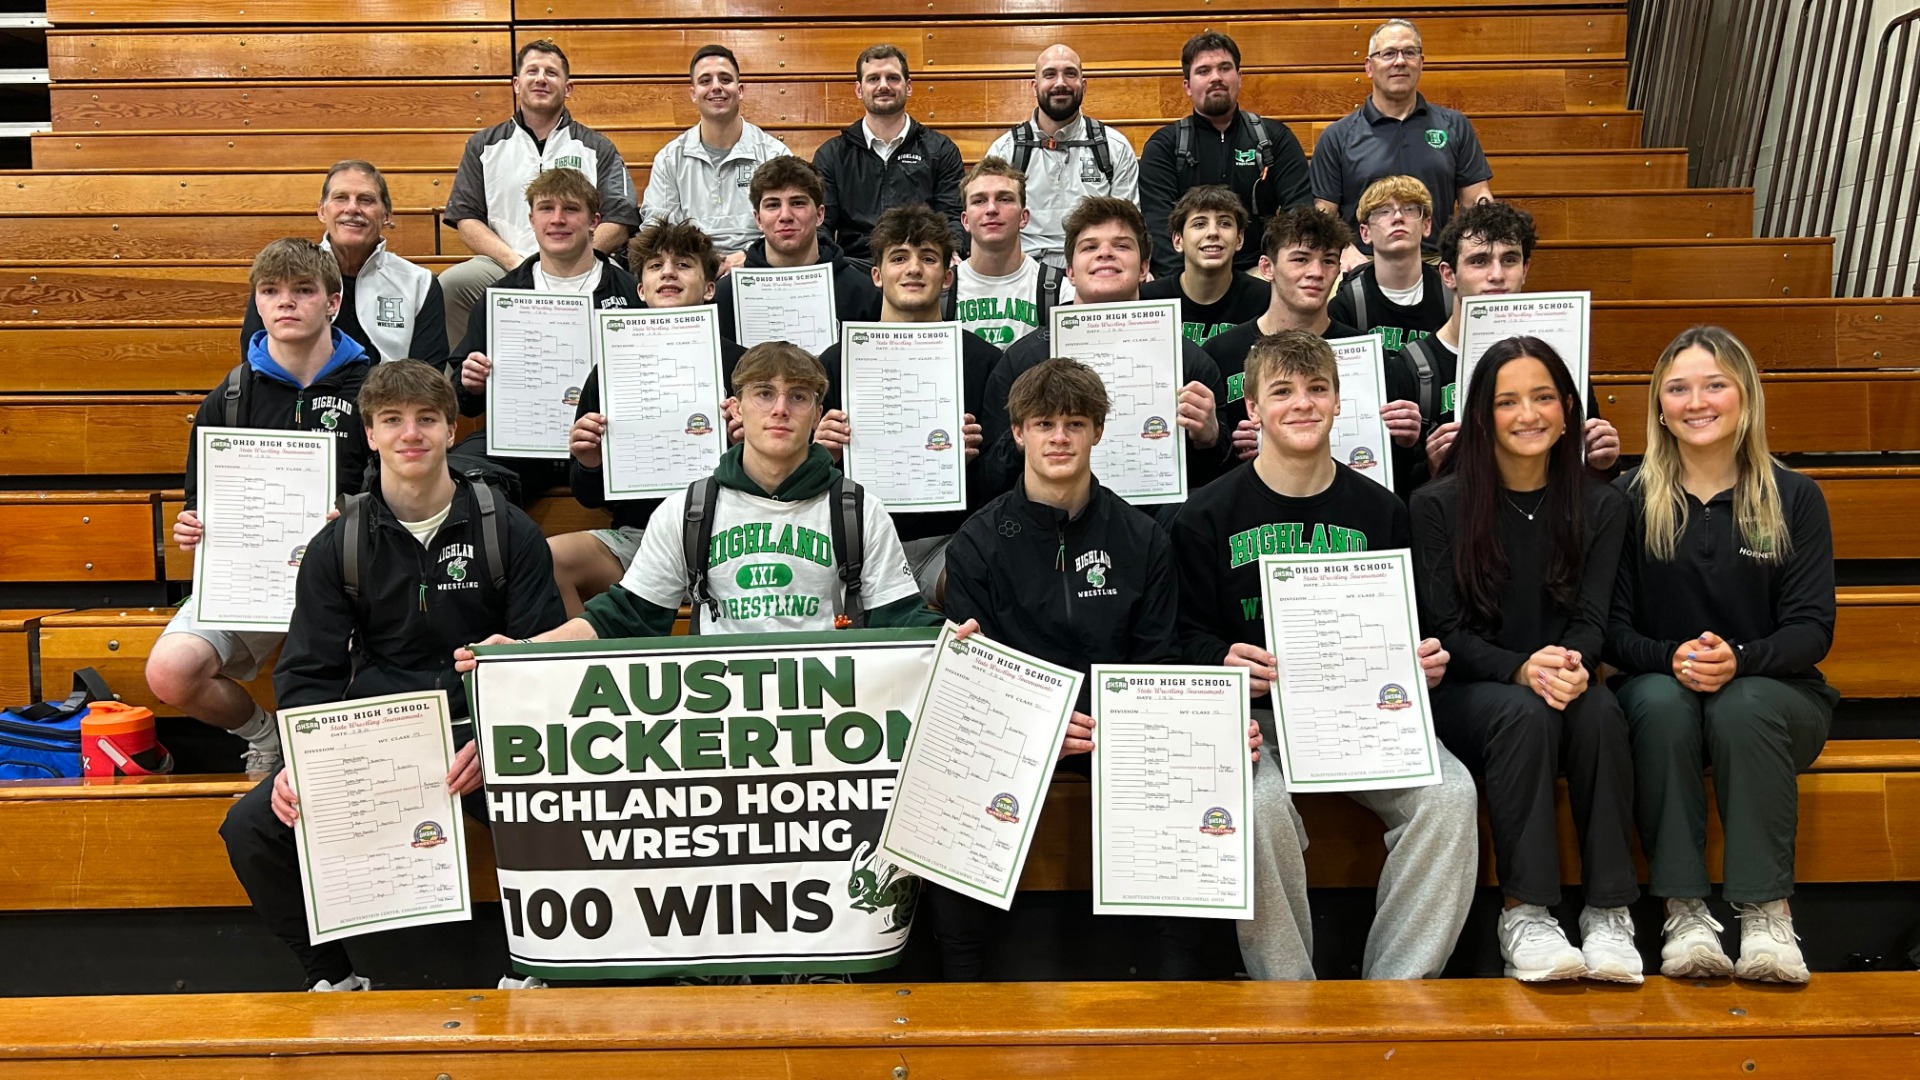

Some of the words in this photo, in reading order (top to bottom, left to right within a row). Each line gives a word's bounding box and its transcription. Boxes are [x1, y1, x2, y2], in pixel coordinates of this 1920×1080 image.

[377, 296, 404, 322] H
[312, 396, 352, 416] HIGHLAND
[311, 428, 348, 438] WREING
[708, 523, 832, 568] HIGHLAND
[1229, 522, 1367, 569] HIGHLAND
[750, 566, 778, 586] XXL
[1354, 563, 1394, 572] SCHOOL
[438, 582, 478, 590] WRESTLING
[1078, 588, 1117, 598] WRESTLING
[971, 646, 993, 661] OHIO
[997, 657, 1021, 672] HIGH
[1025, 668, 1062, 687] SCHOOL
[975, 657, 988, 668] State
[990, 663, 1016, 680] Wrestling
[569, 656, 857, 718] AUSTIN
[322, 715, 348, 724] OHIO
[354, 709, 381, 720] HIGH
[387, 703, 430, 714] SCHOOL
[350, 719, 380, 729] Wrestling
[487, 785, 722, 823] HIGHLAND
[737, 778, 896, 815] HORNE
[582, 820, 852, 861] WRESTLING
[503, 887, 612, 940] 100
[634, 879, 834, 938] WINS
